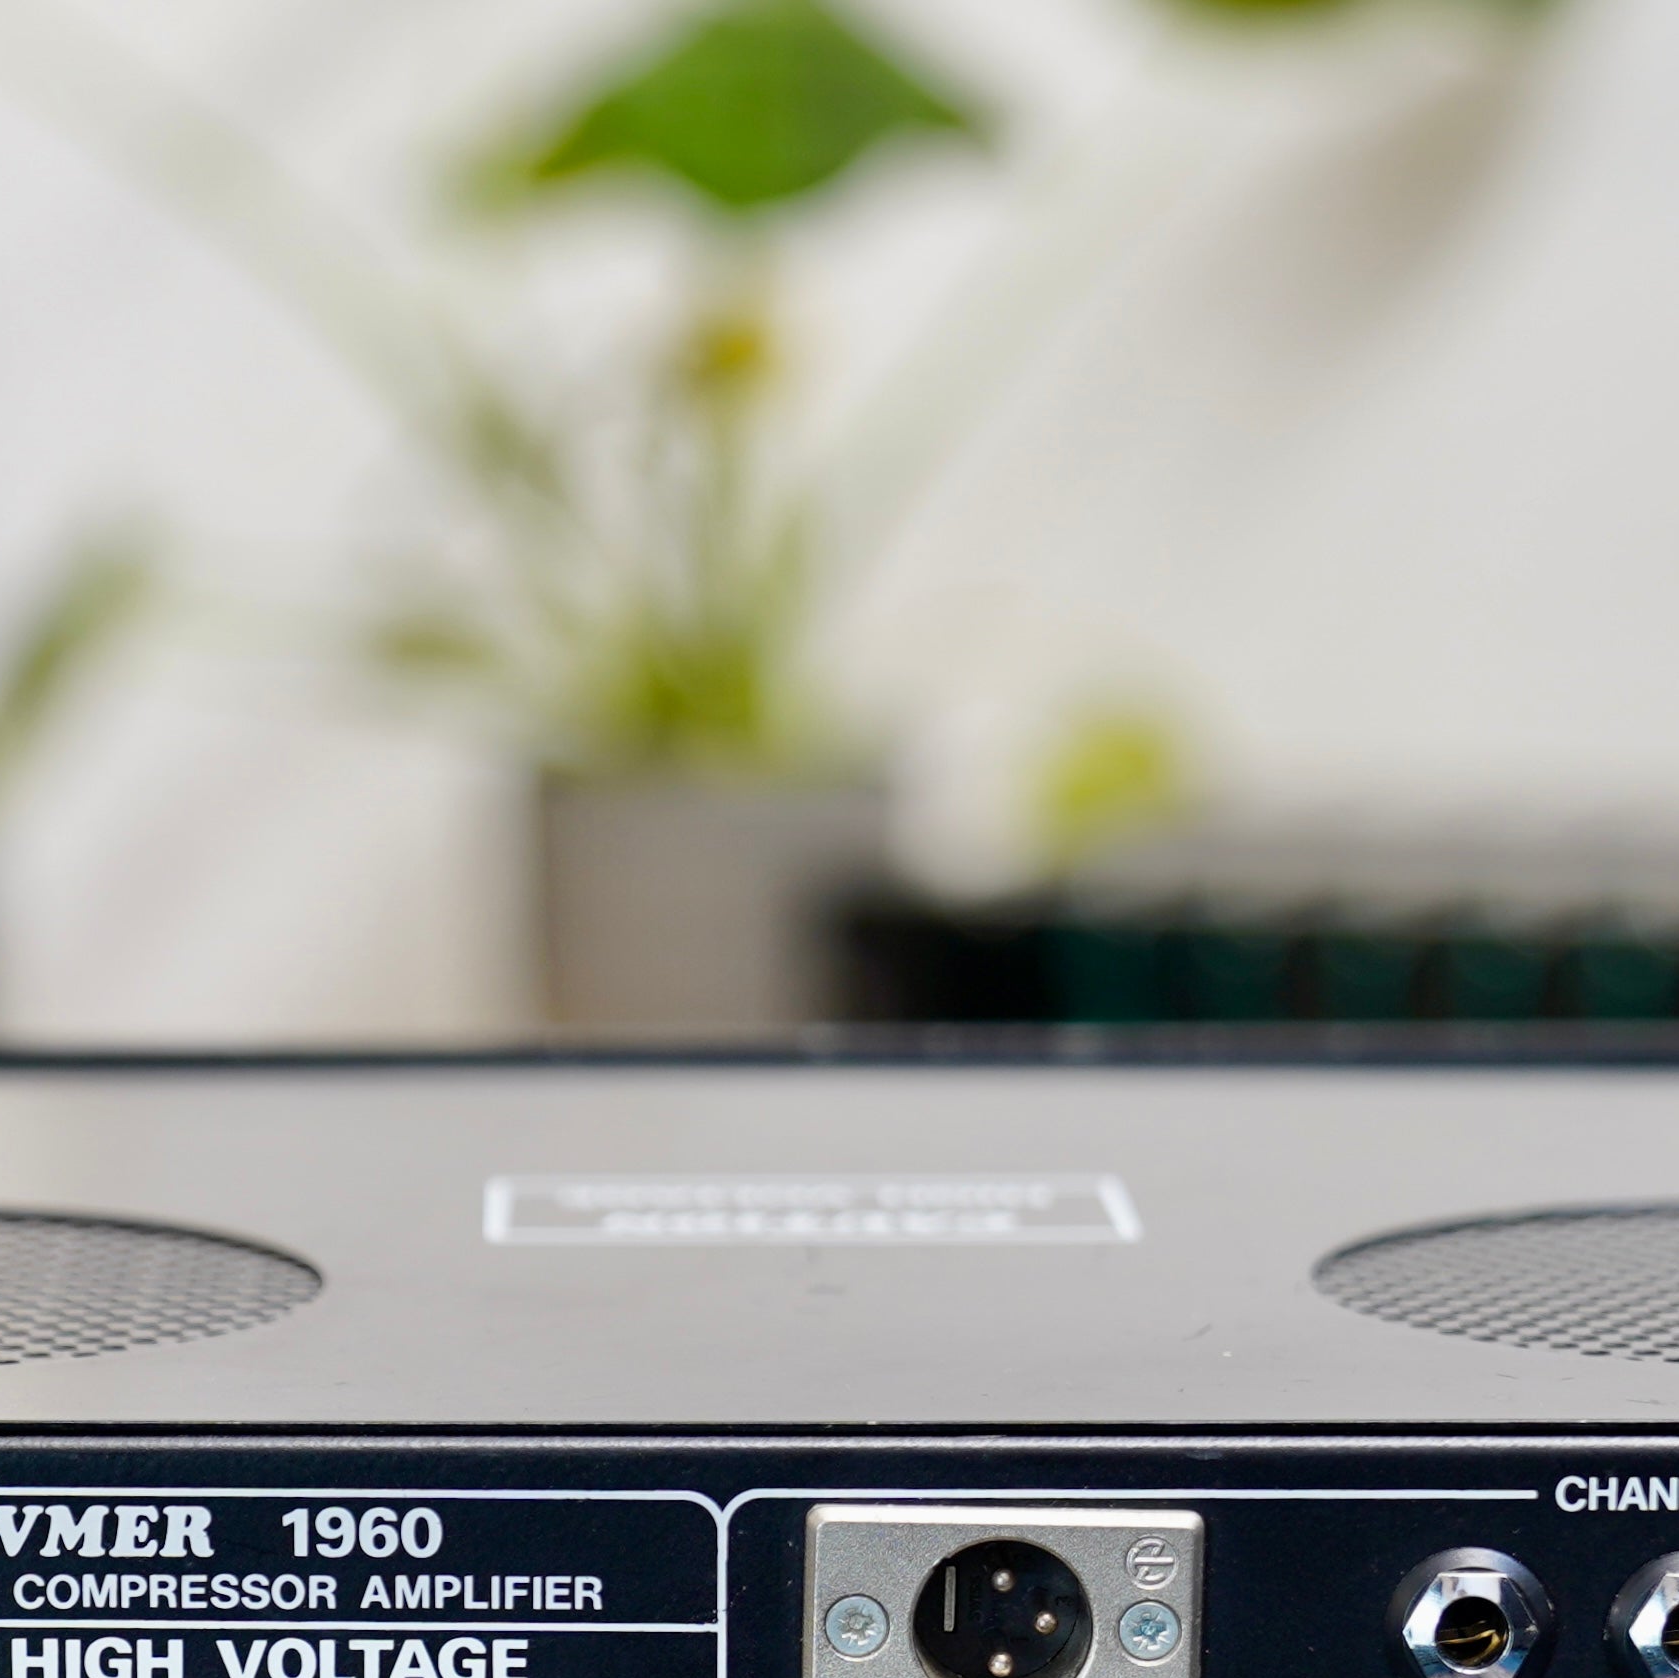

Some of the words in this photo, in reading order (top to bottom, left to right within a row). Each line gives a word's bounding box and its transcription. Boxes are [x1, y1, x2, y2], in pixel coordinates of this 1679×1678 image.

[282, 1507, 442, 1558] 1960
[14, 1574, 336, 1609] COMPRESSOR
[361, 1575, 602, 1610] AMPLIFIER
